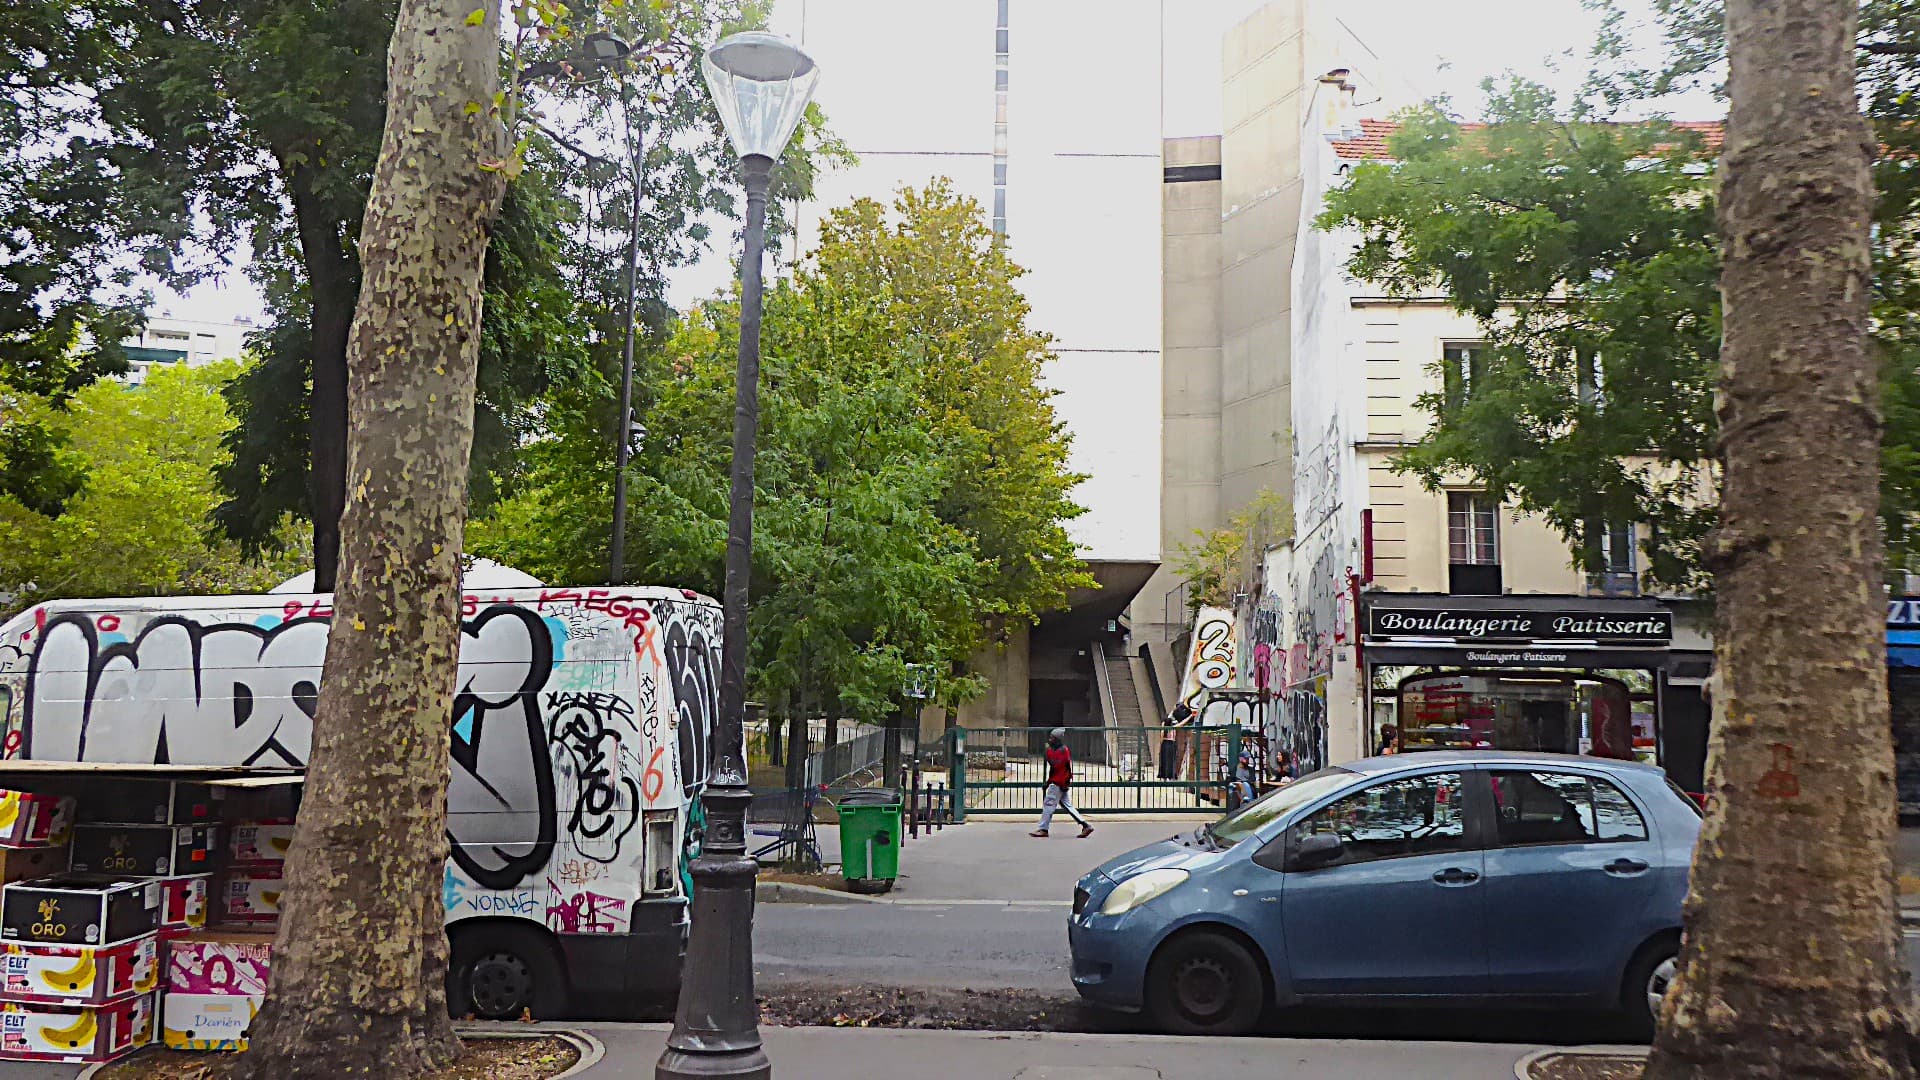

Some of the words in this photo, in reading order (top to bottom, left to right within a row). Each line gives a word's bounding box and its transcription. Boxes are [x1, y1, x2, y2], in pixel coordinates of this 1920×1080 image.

[1380, 611, 1532, 637] Boulangerie
[1552, 616, 1666, 634] Patisserie
[1466, 650, 1521, 663] Boulangerie
[1522, 652, 1567, 662] Patisserie
[31, 922, 67, 936] ORO
